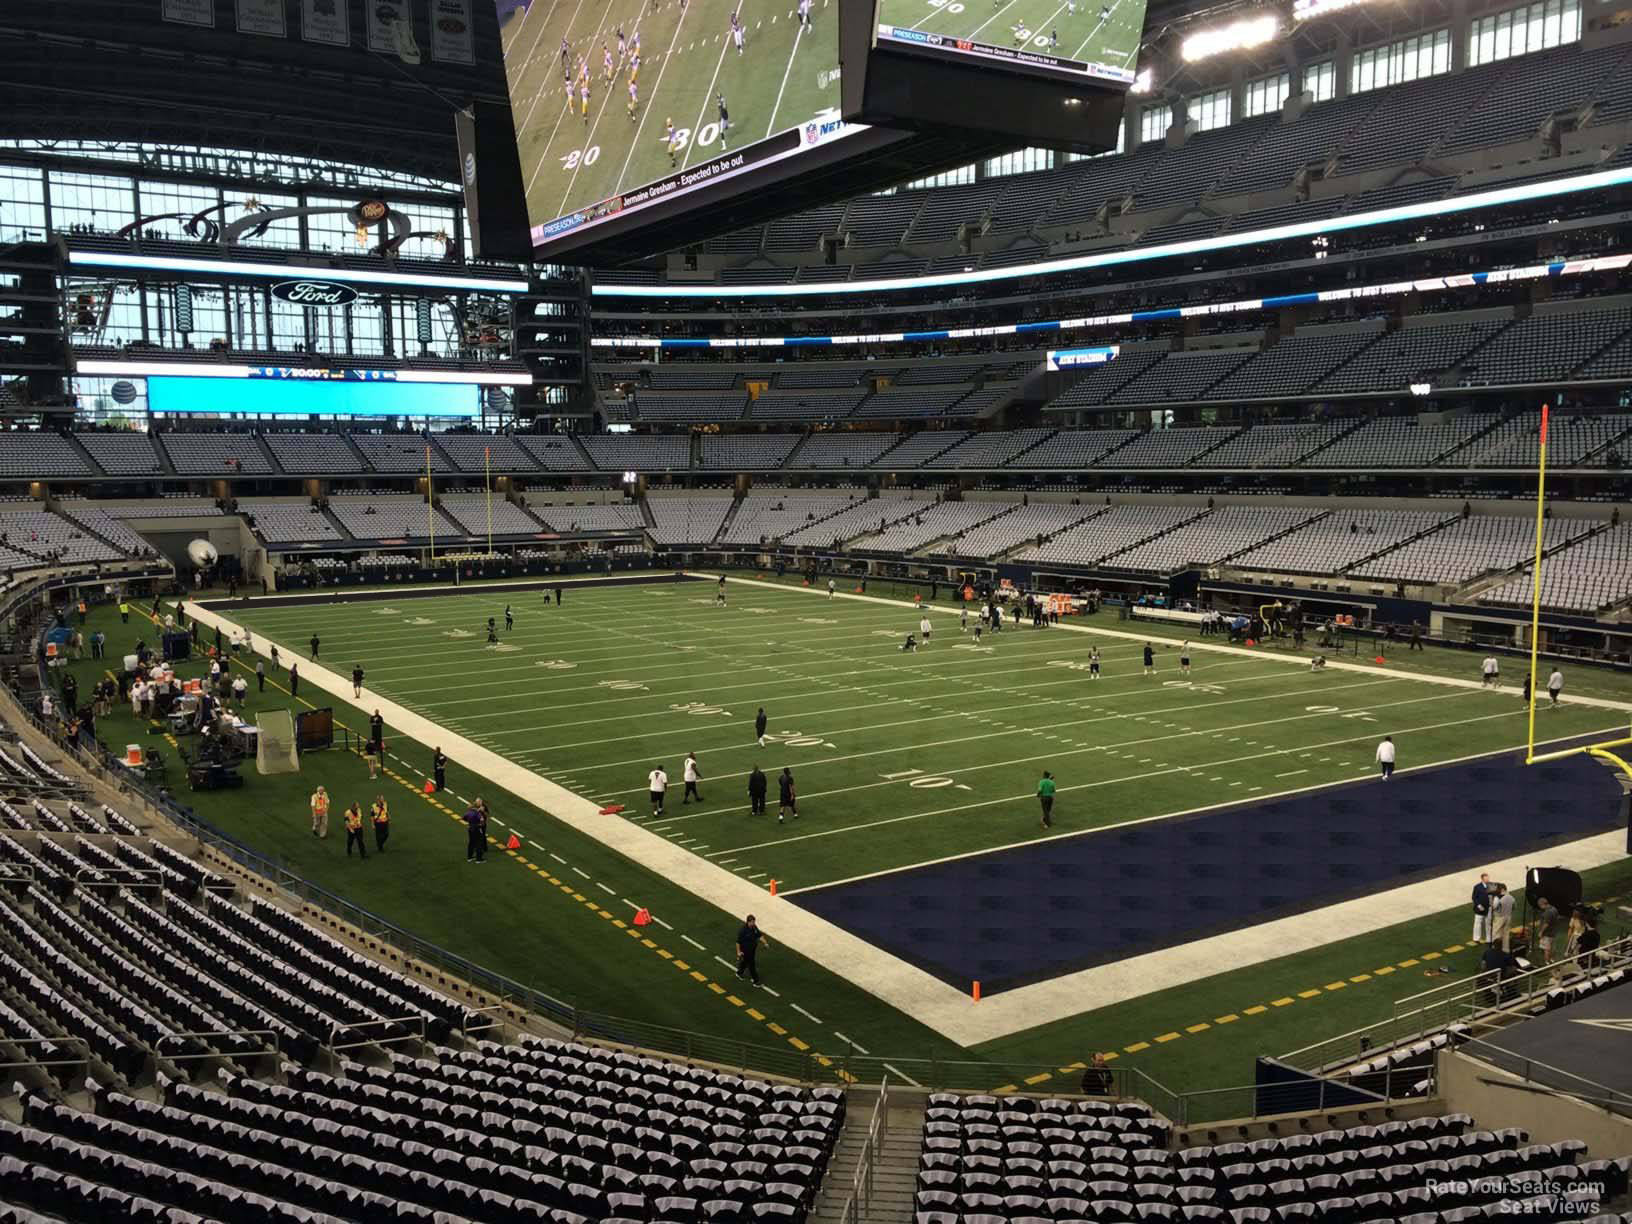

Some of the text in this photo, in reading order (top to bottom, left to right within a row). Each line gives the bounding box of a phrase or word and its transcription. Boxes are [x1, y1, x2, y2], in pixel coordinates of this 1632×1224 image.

[563, 146, 600, 170] 20
[624, 191, 649, 206] Jermaine
[649, 181, 677, 198] Gresham
[681, 165, 712, 185] Expected
[712, 164, 720, 174] to
[720, 160, 730, 171] be
[731, 154, 744, 168] out
[288, 283, 342, 303] Ford
[878, 768, 954, 788] 10
